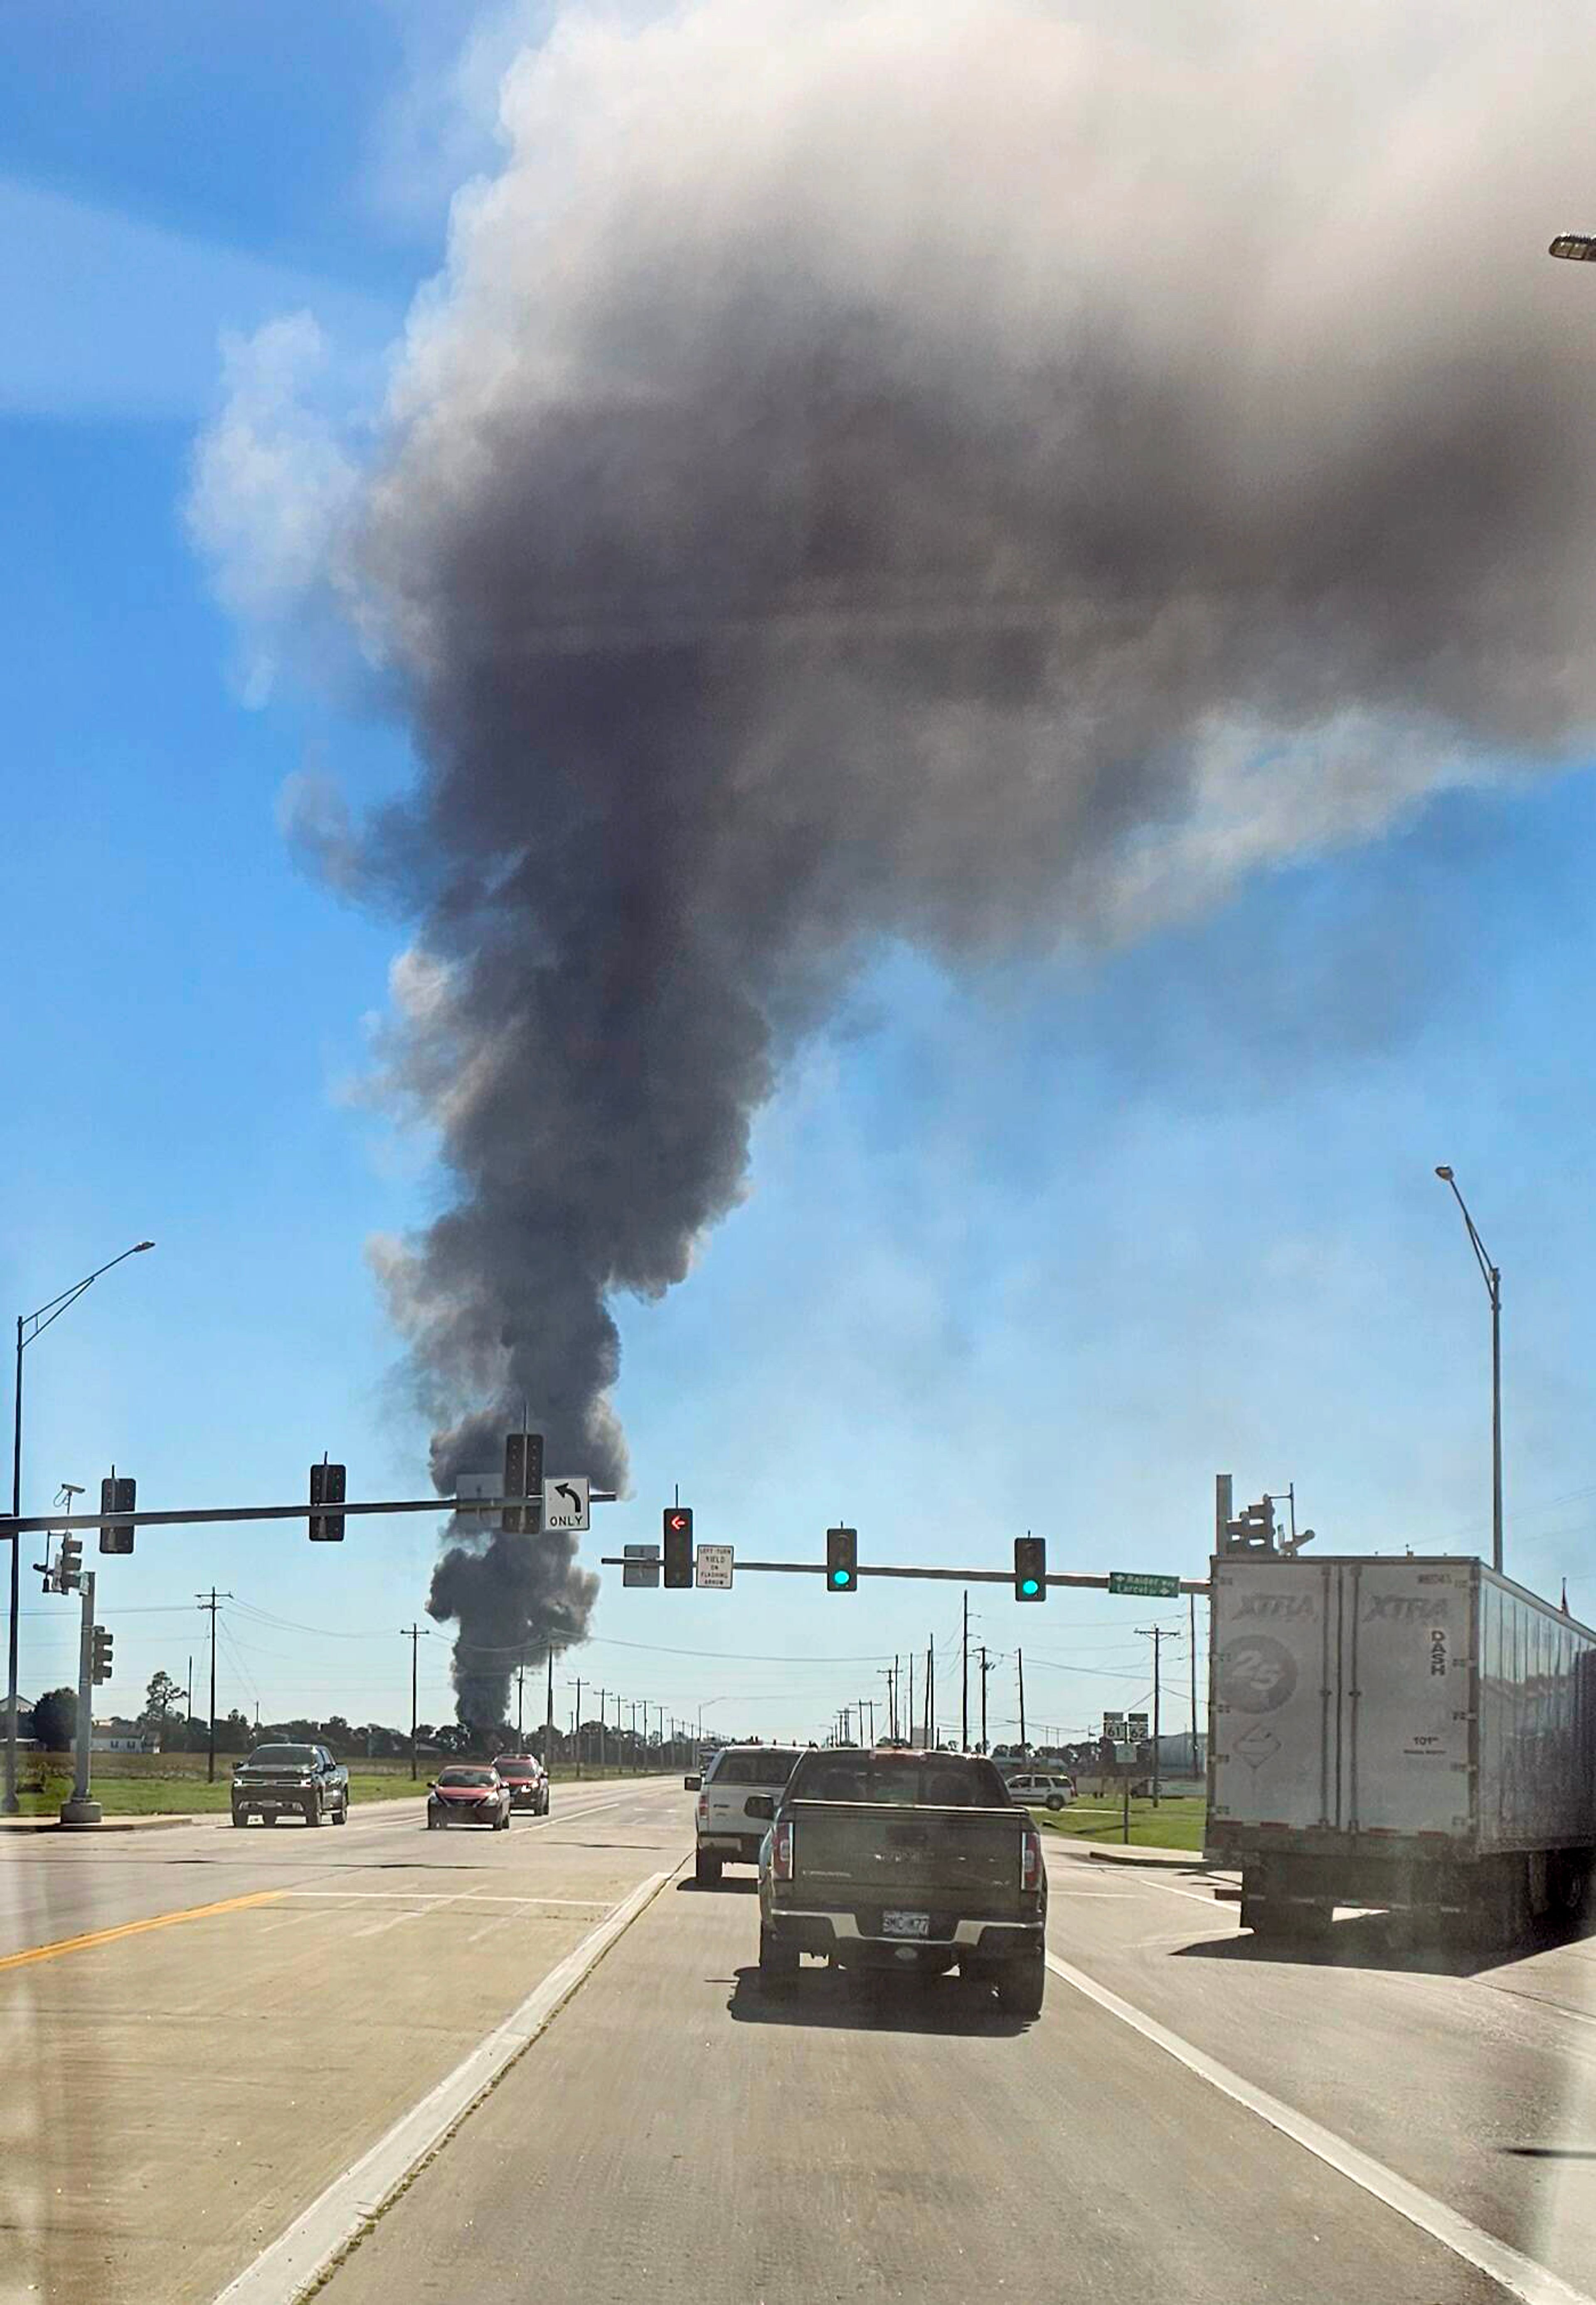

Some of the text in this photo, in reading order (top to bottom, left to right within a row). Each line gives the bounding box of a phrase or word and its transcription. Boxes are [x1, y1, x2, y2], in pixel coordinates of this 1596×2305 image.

[550, 1516, 583, 1526] ONLY
[1231, 1593, 1315, 1620] XTRA
[1361, 1595, 1449, 1623] XTRA
[1431, 1630, 1446, 1676] DASH
[1108, 1726, 1120, 1737] 61
[1130, 1727, 1146, 1738] 62
